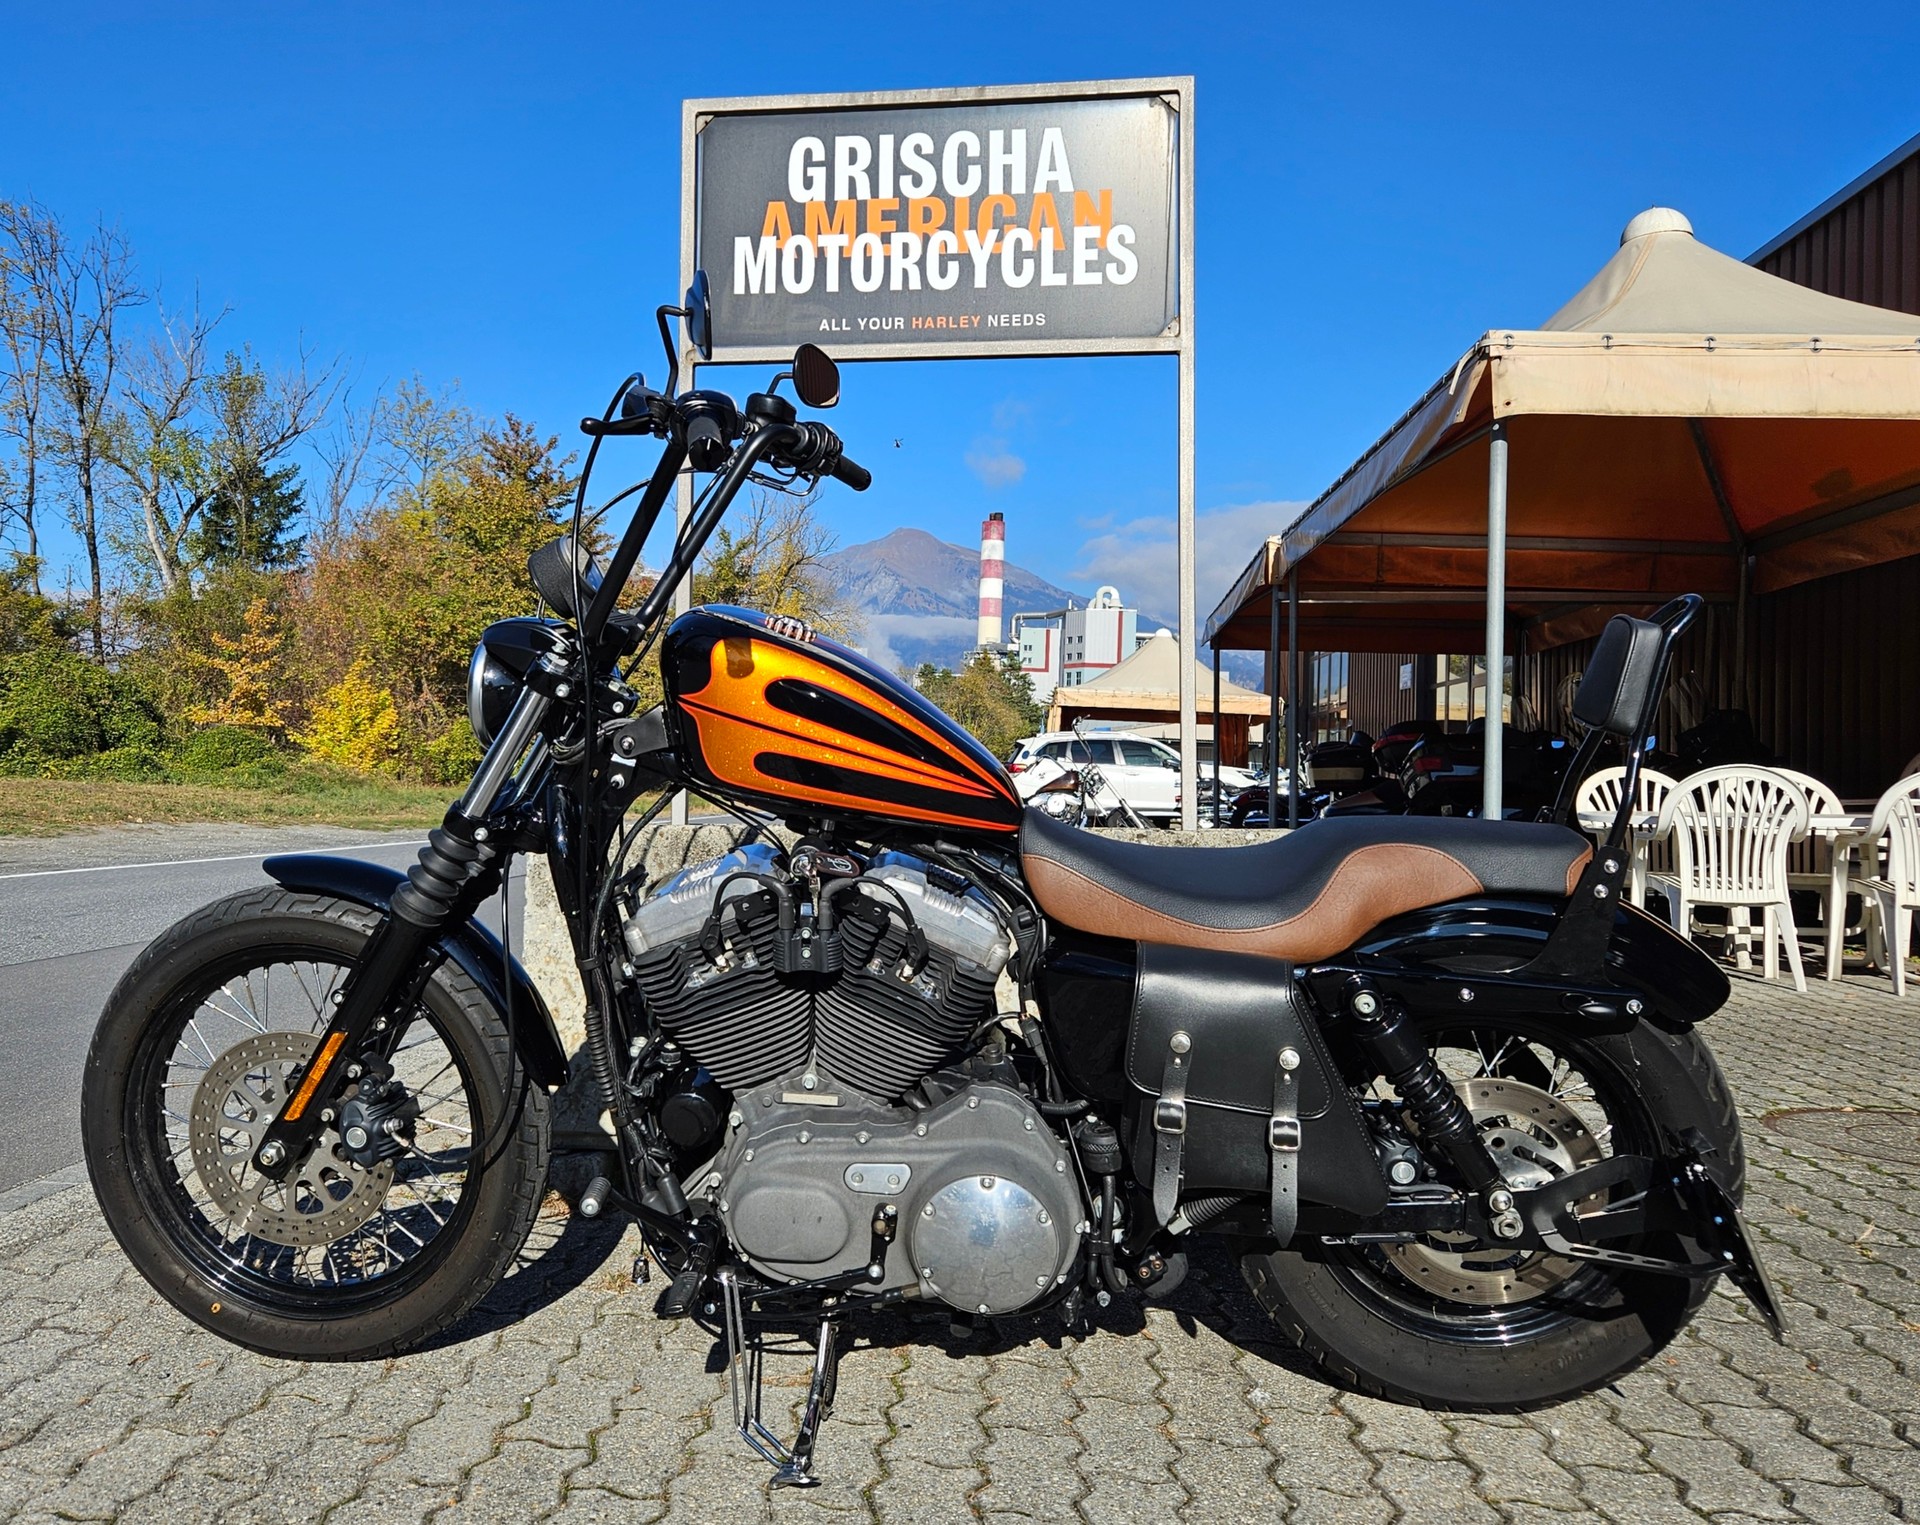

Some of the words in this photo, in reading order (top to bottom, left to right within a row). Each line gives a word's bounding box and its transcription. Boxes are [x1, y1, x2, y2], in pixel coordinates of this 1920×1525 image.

[788, 127, 1075, 203] GRISCHA
[761, 189, 1113, 258] AMERICAN
[733, 224, 1139, 295] MOTORCYCLES
[819, 318, 851, 331] ALL
[858, 317, 905, 330] YOUR
[912, 315, 981, 329] HARLEY
[988, 313, 1046, 327] NEEDS
